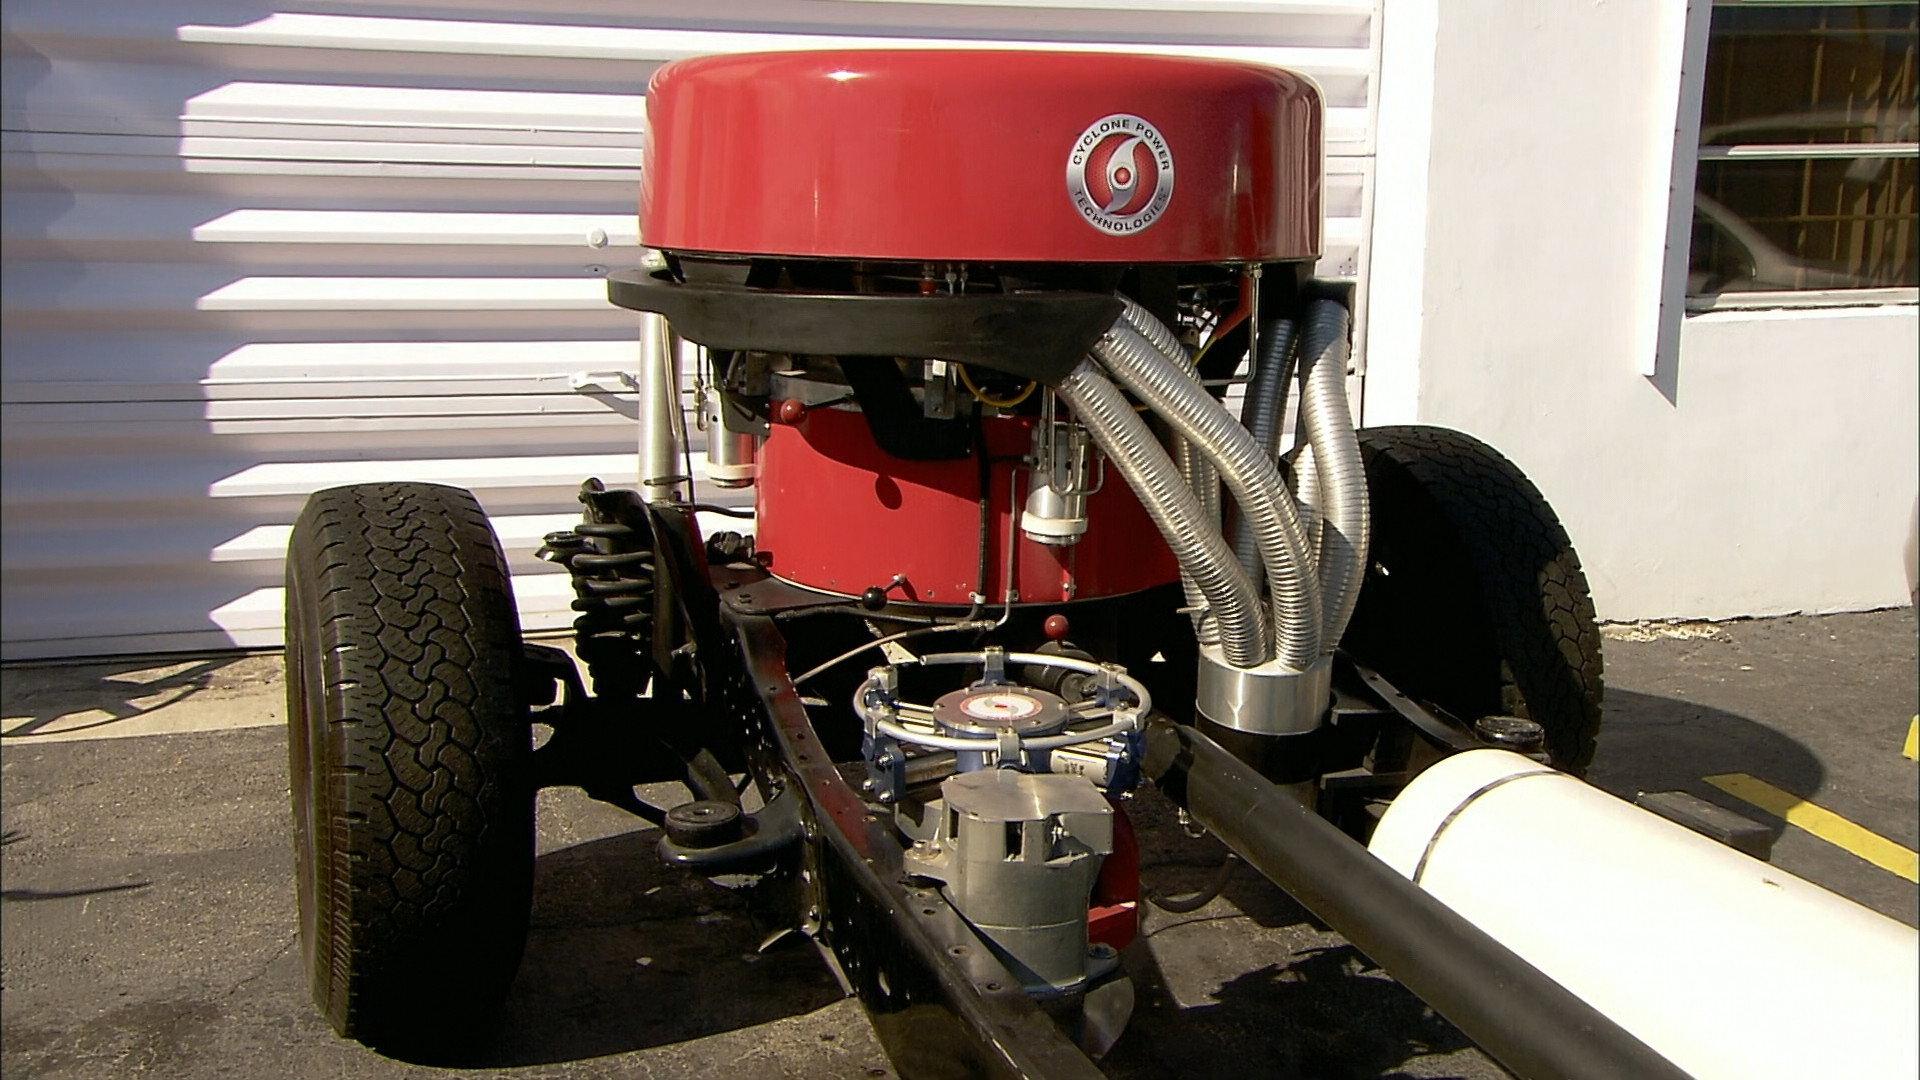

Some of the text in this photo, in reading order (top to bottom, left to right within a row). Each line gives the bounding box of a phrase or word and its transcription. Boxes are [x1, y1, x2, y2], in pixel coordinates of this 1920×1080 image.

[1073, 119, 1170, 170] CYCLONE POWER
[1074, 189, 1168, 231] TECHNOLOGIES
